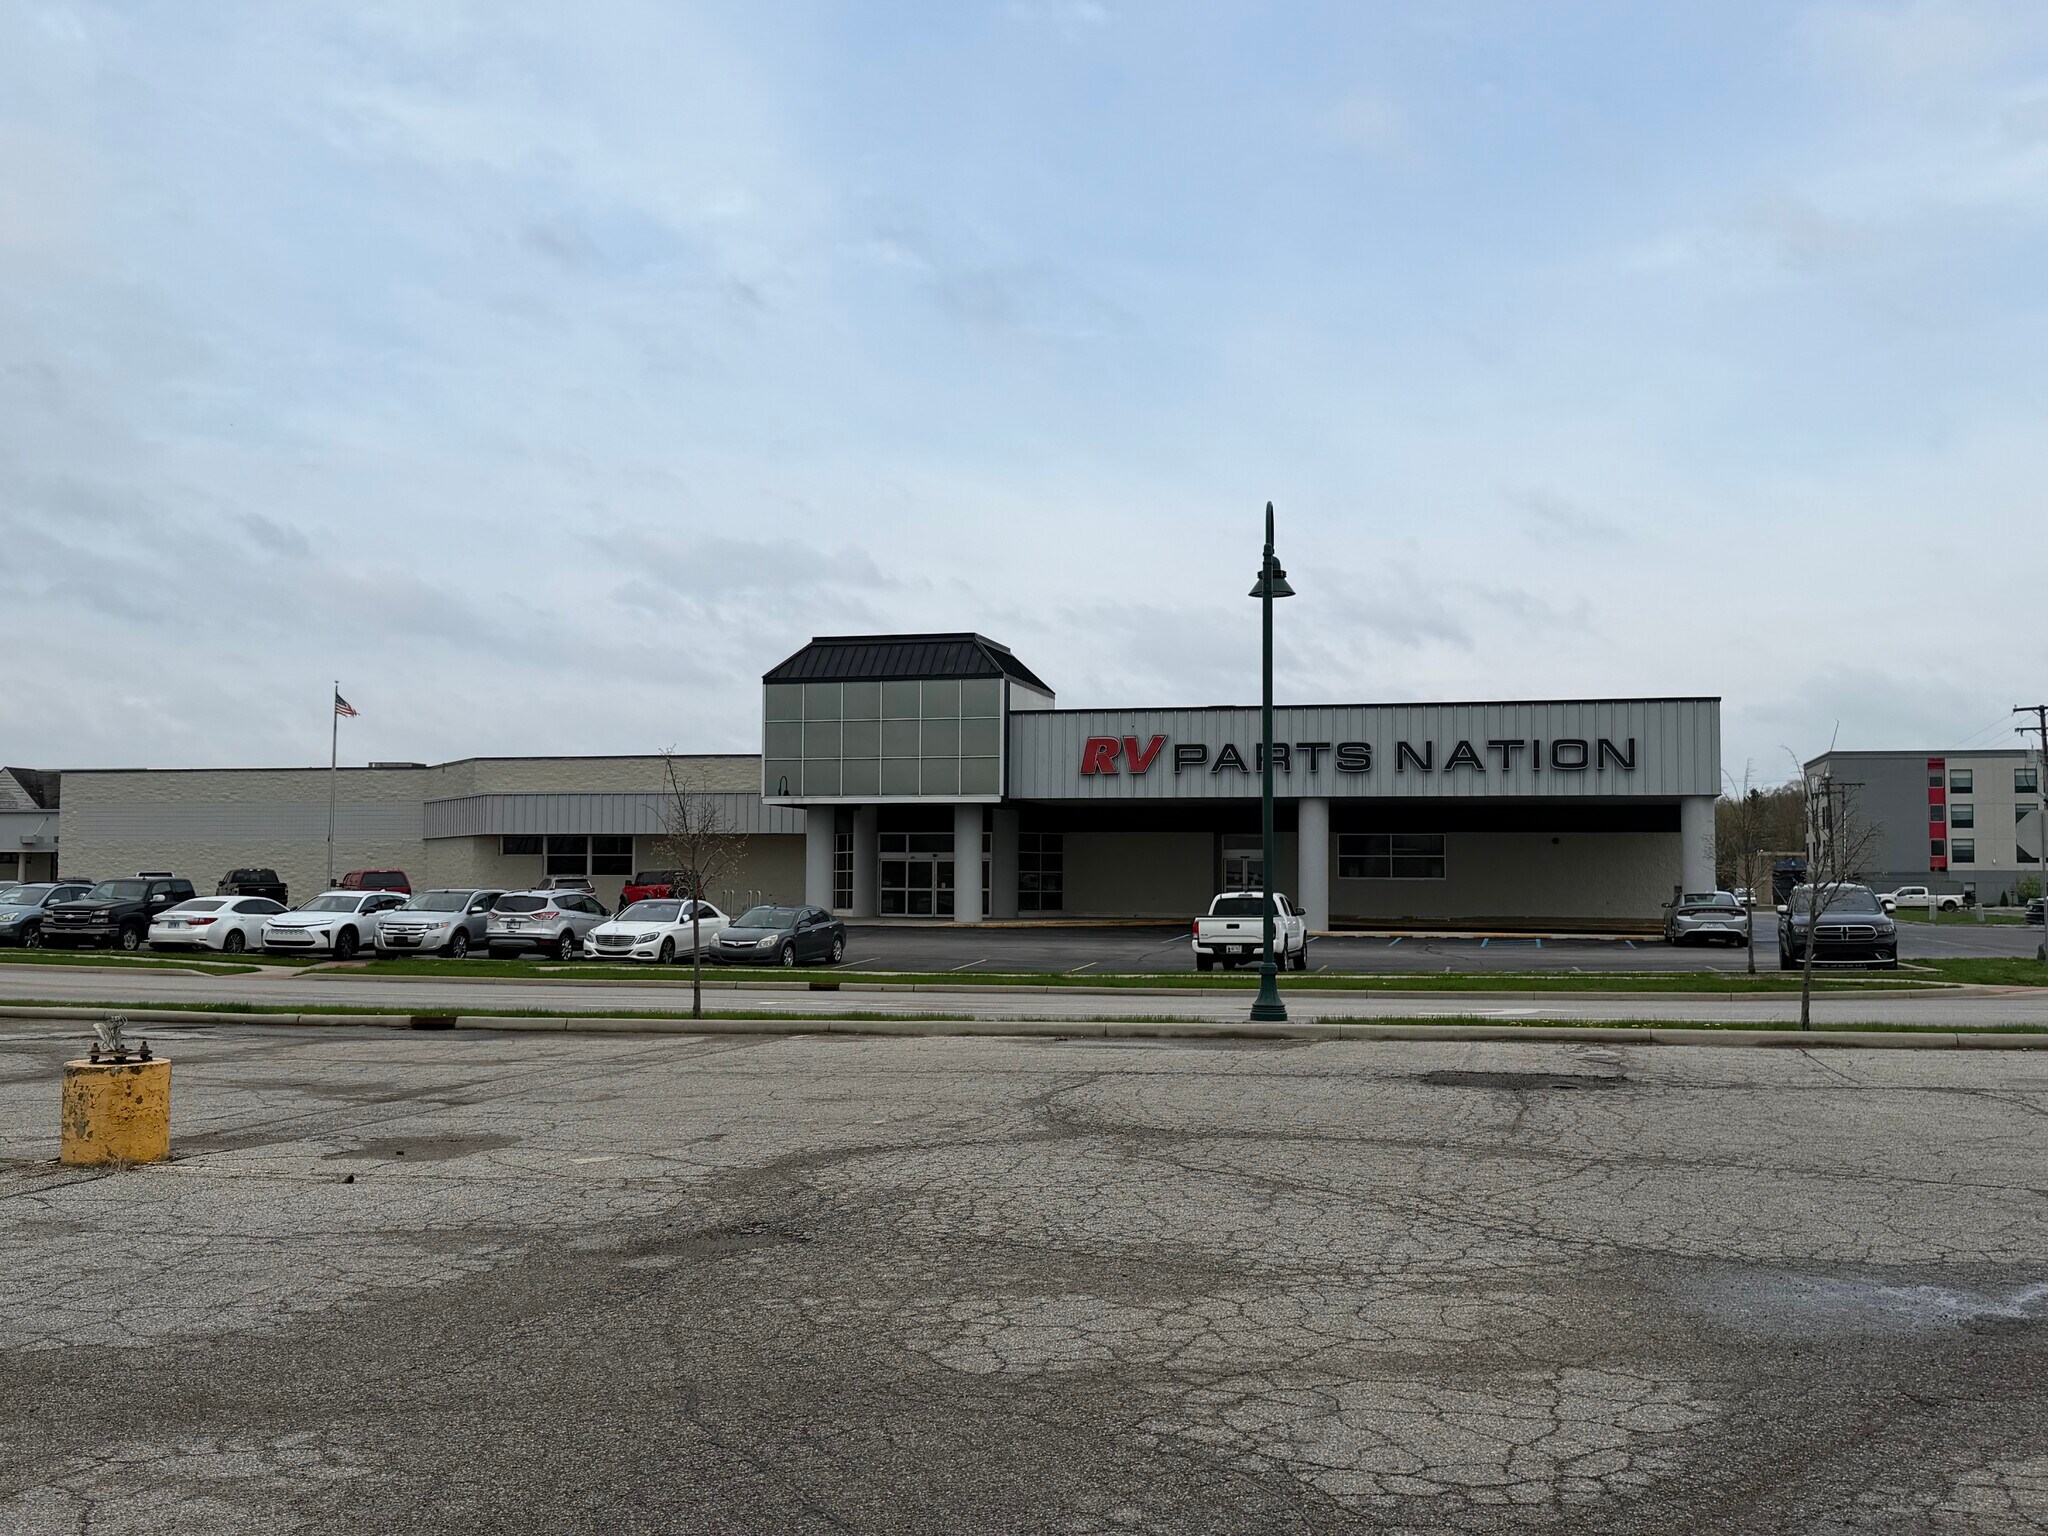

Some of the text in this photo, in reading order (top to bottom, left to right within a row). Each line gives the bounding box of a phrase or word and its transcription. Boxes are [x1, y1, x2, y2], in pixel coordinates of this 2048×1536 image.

[1080, 734, 1636, 775] RV PARTS NATION
